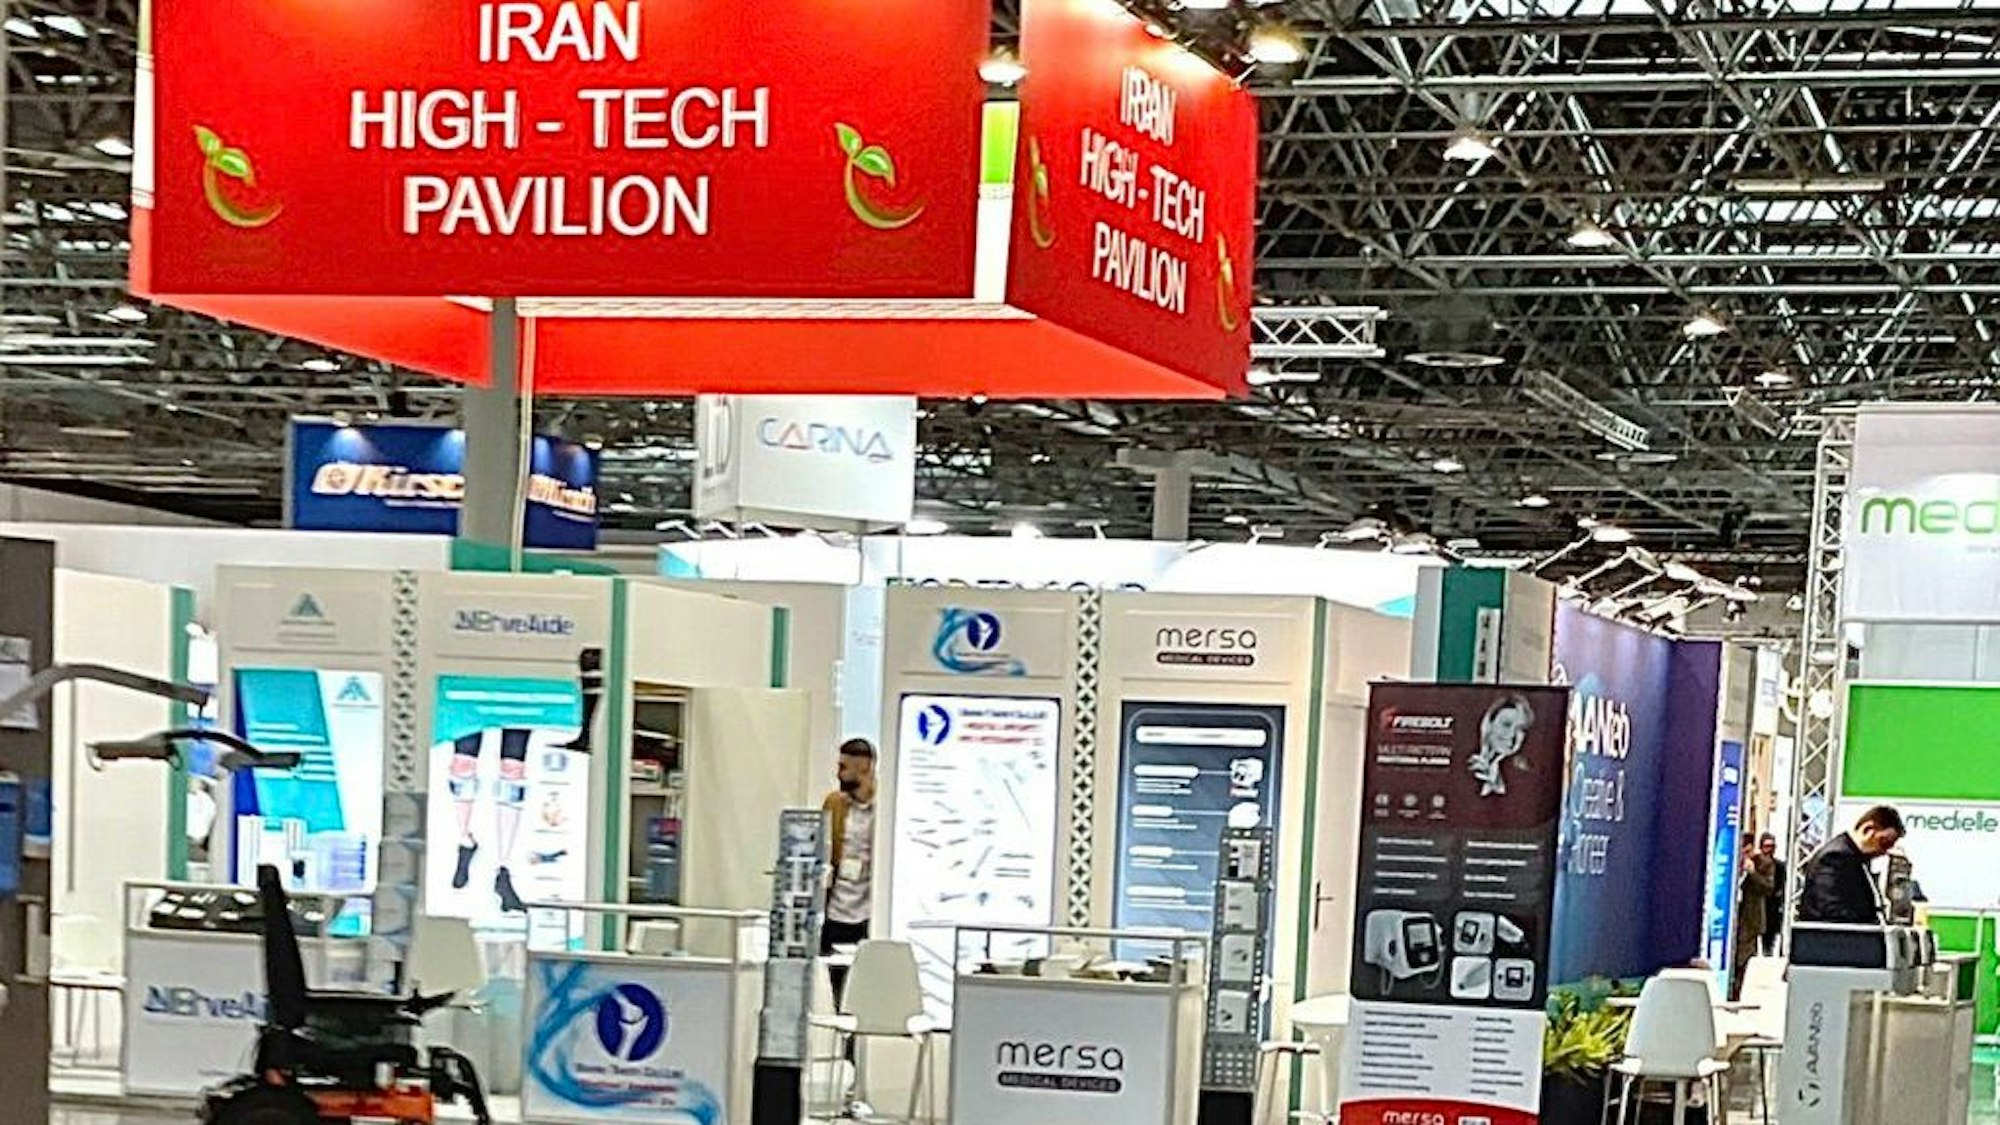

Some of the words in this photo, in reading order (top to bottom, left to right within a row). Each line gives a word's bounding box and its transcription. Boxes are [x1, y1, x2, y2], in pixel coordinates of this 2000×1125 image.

[479, 0, 642, 62] IRAN
[350, 88, 521, 150] HIGH
[577, 86, 770, 149] TECH
[403, 174, 710, 236] PAVILION
[1080, 126, 1139, 209] HIGH
[1150, 164, 1206, 244] TECH
[1092, 221, 1188, 315] PAVILION
[757, 407, 894, 463] CARINA
[1155, 627, 1257, 650] mersa
[998, 1041, 1124, 1071] mersa
[1000, 1073, 1058, 1088] MEDICAL
[1060, 1076, 1118, 1092] DEVICES
[1382, 1109, 1445, 1125] mersa
